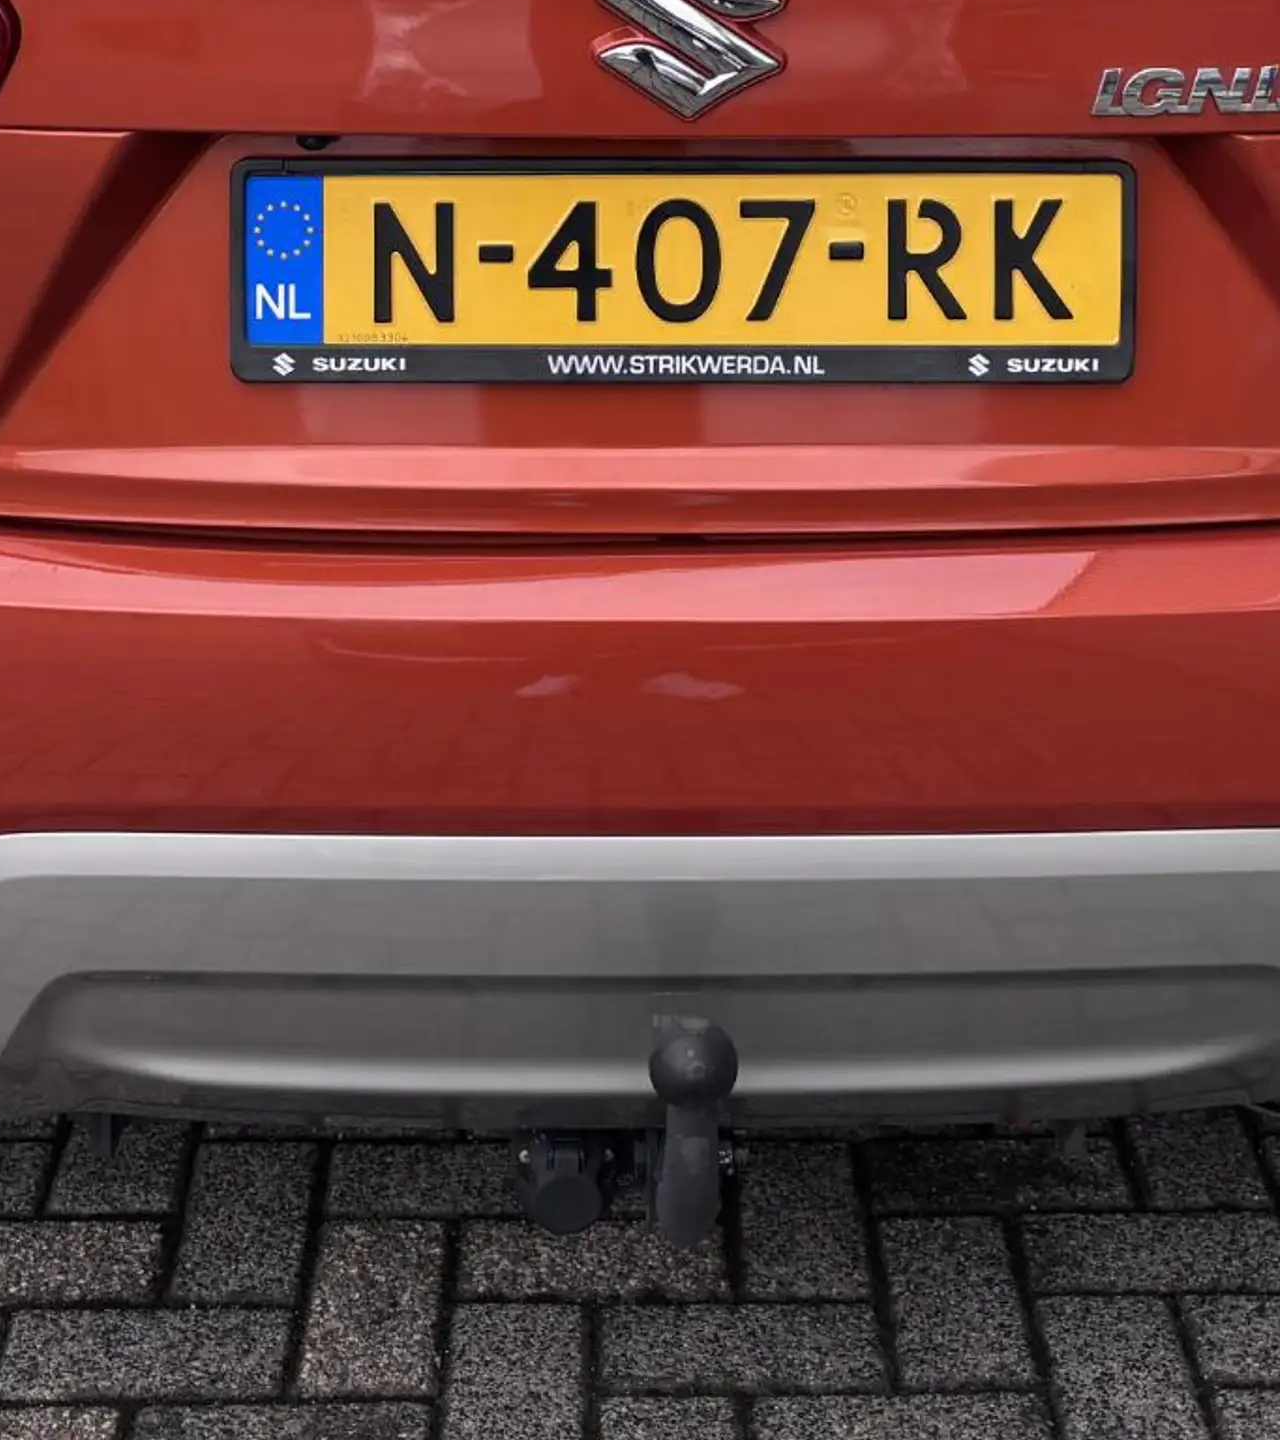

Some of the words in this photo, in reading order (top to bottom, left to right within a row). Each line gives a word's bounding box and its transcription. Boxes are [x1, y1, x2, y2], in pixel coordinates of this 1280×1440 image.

[373, 198, 1074, 323] N-407-RK
[255, 283, 311, 320] NL
[312, 357, 406, 372] SUZUKI
[547, 355, 826, 375] WWW.STRIKWERDA.NL
[1007, 357, 1099, 373] SUZUKI
